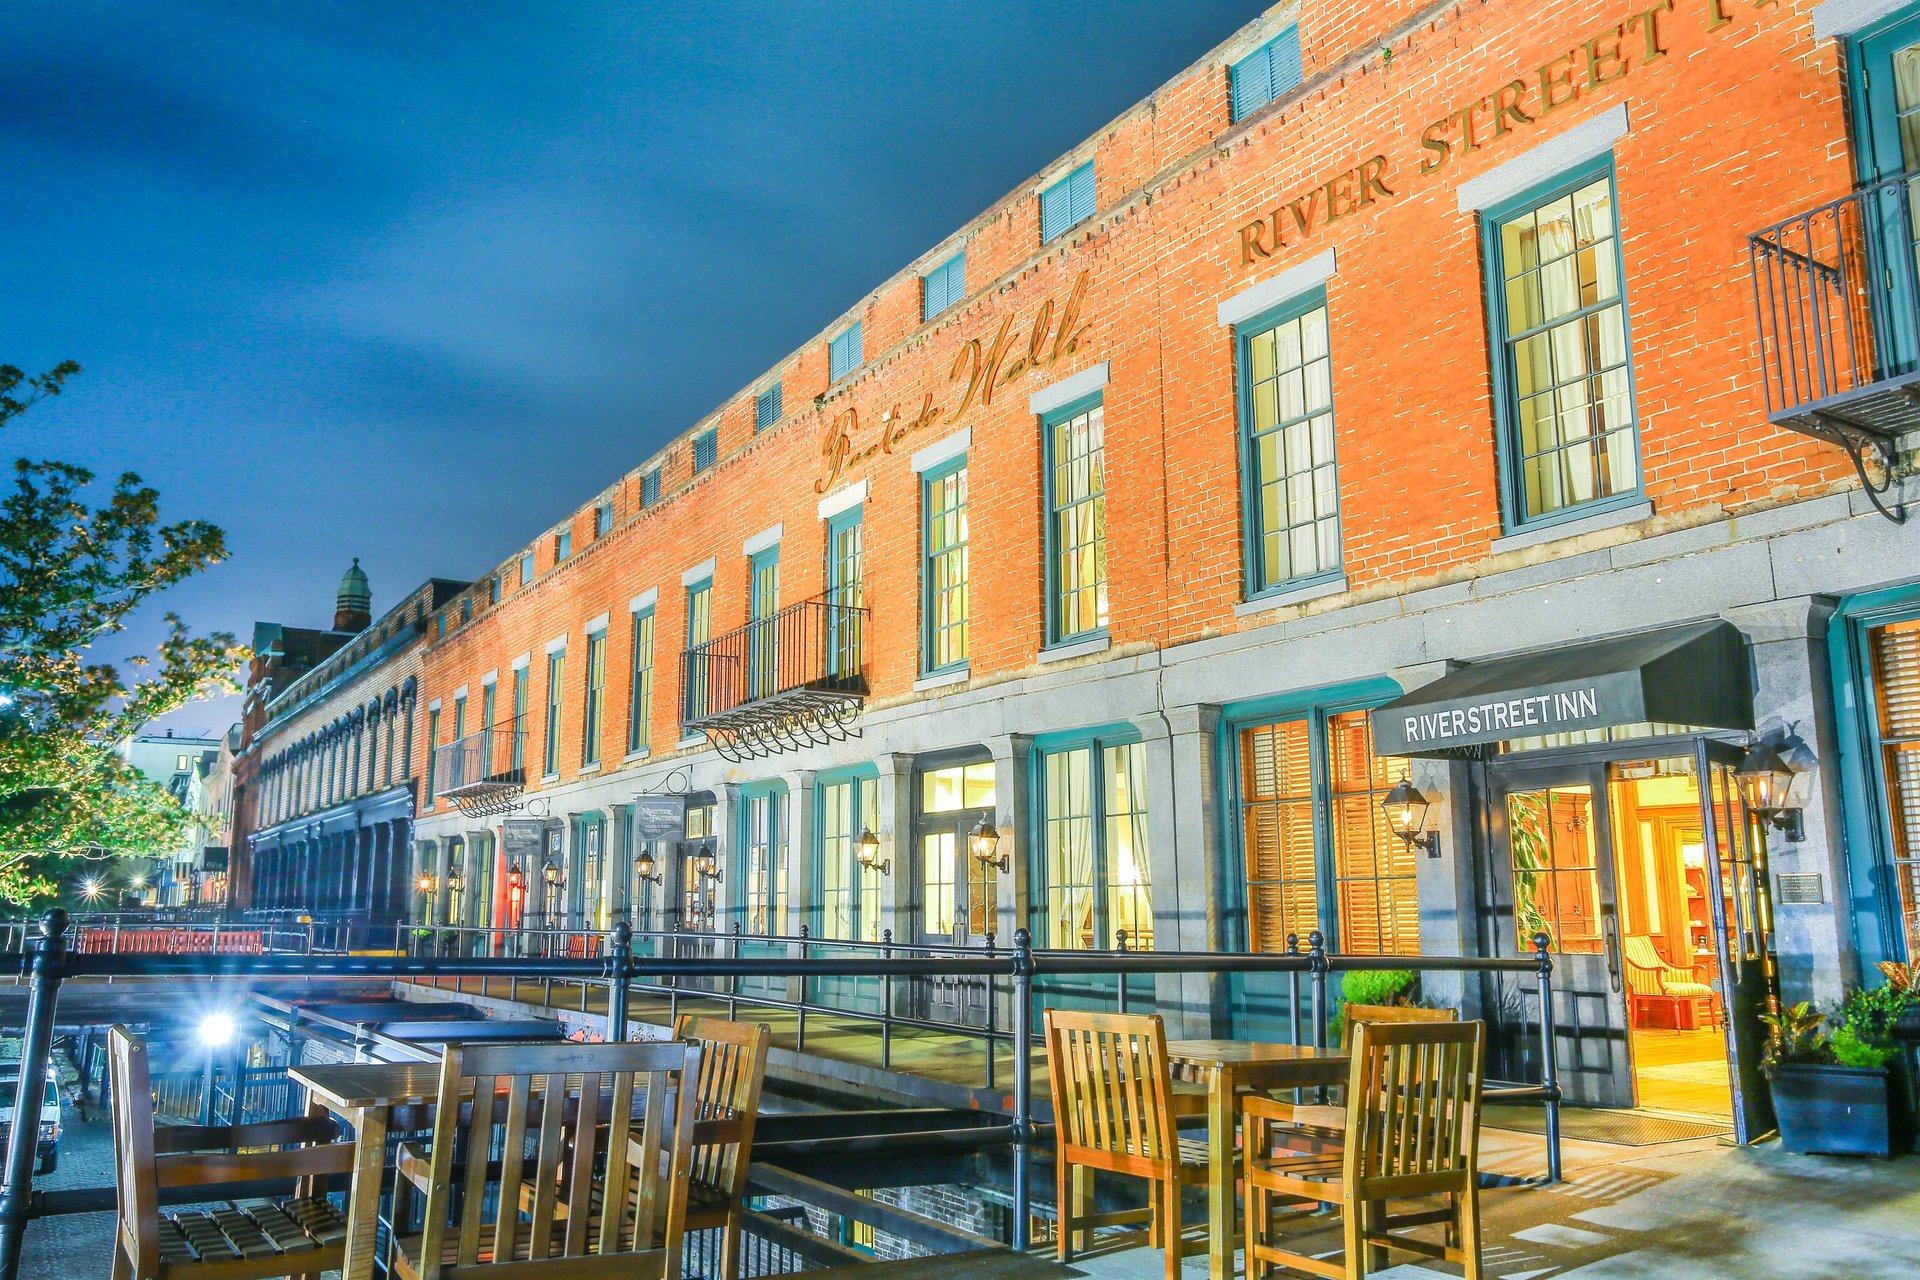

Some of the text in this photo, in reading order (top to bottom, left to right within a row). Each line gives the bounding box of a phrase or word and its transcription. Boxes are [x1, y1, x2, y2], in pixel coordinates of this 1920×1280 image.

[1238, 0, 1674, 269] RIVER STREET
[943, 270, 1093, 425] Walk
[1403, 687, 1599, 743] RIVER STREET INN
